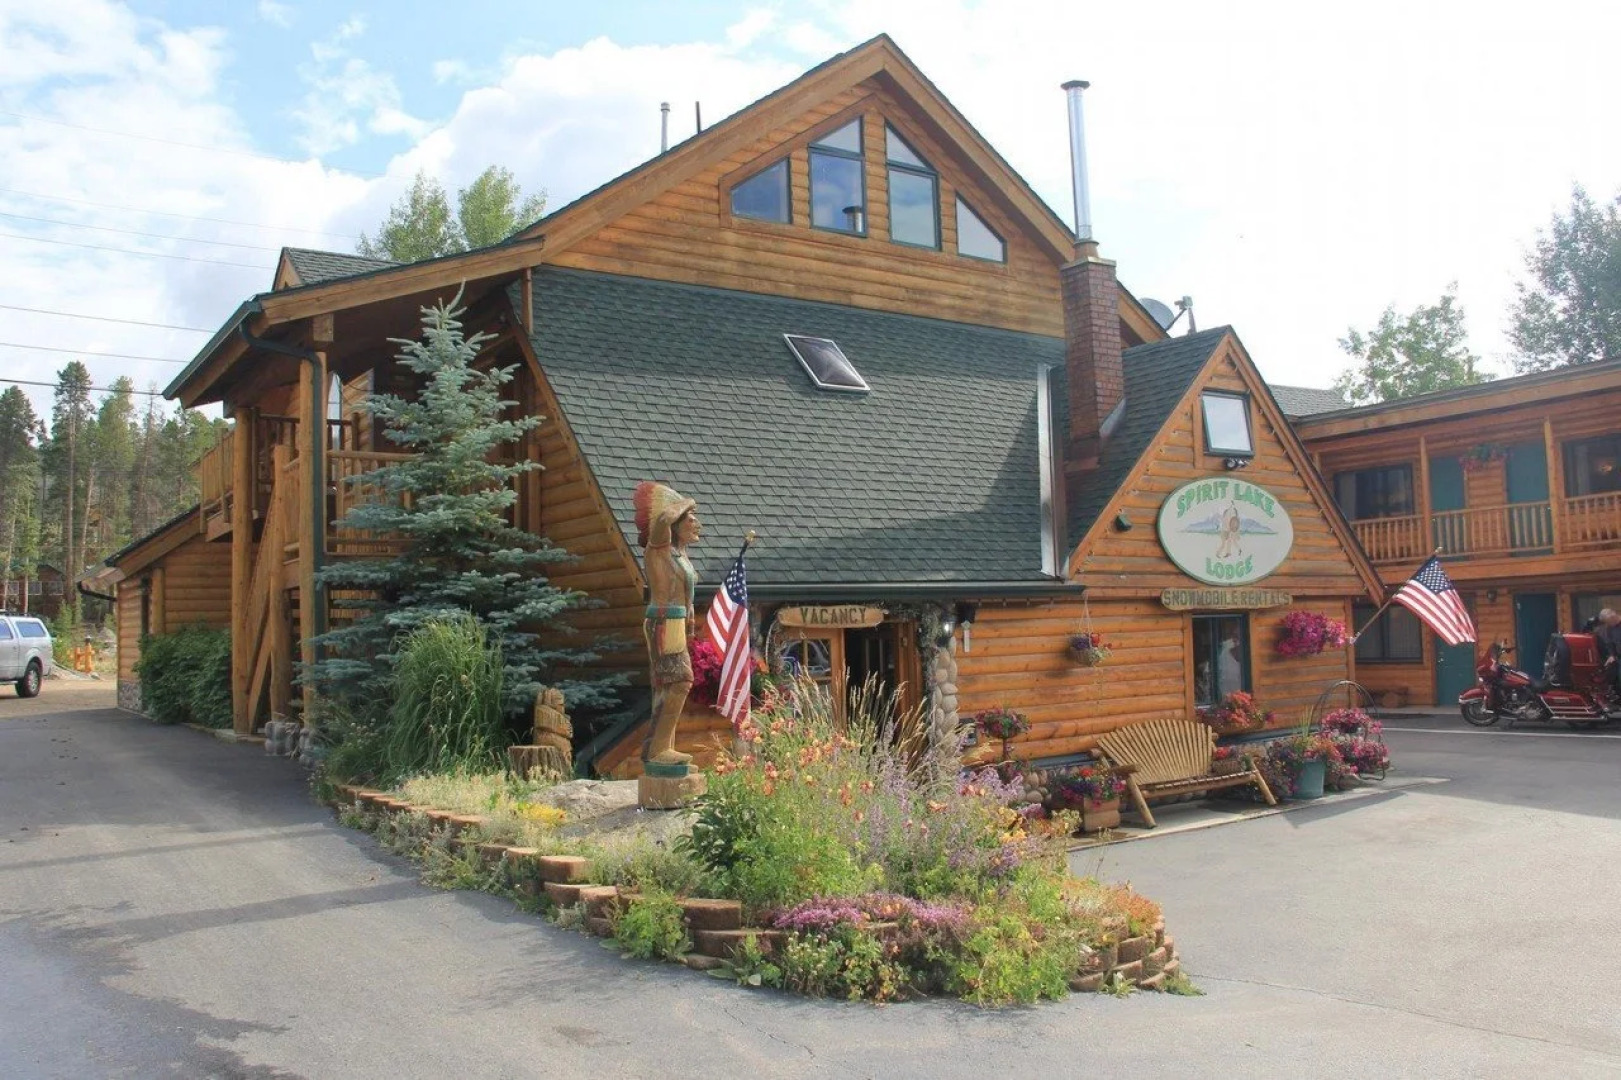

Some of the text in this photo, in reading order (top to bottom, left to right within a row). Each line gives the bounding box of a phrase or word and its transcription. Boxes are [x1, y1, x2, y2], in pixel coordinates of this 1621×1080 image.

[1177, 481, 1275, 518] SPIRIT LAKE
[1205, 555, 1253, 580] LODGE
[1163, 590, 1290, 606] SNOWMOBILE RENTALS
[800, 607, 866, 625] VACANCY
